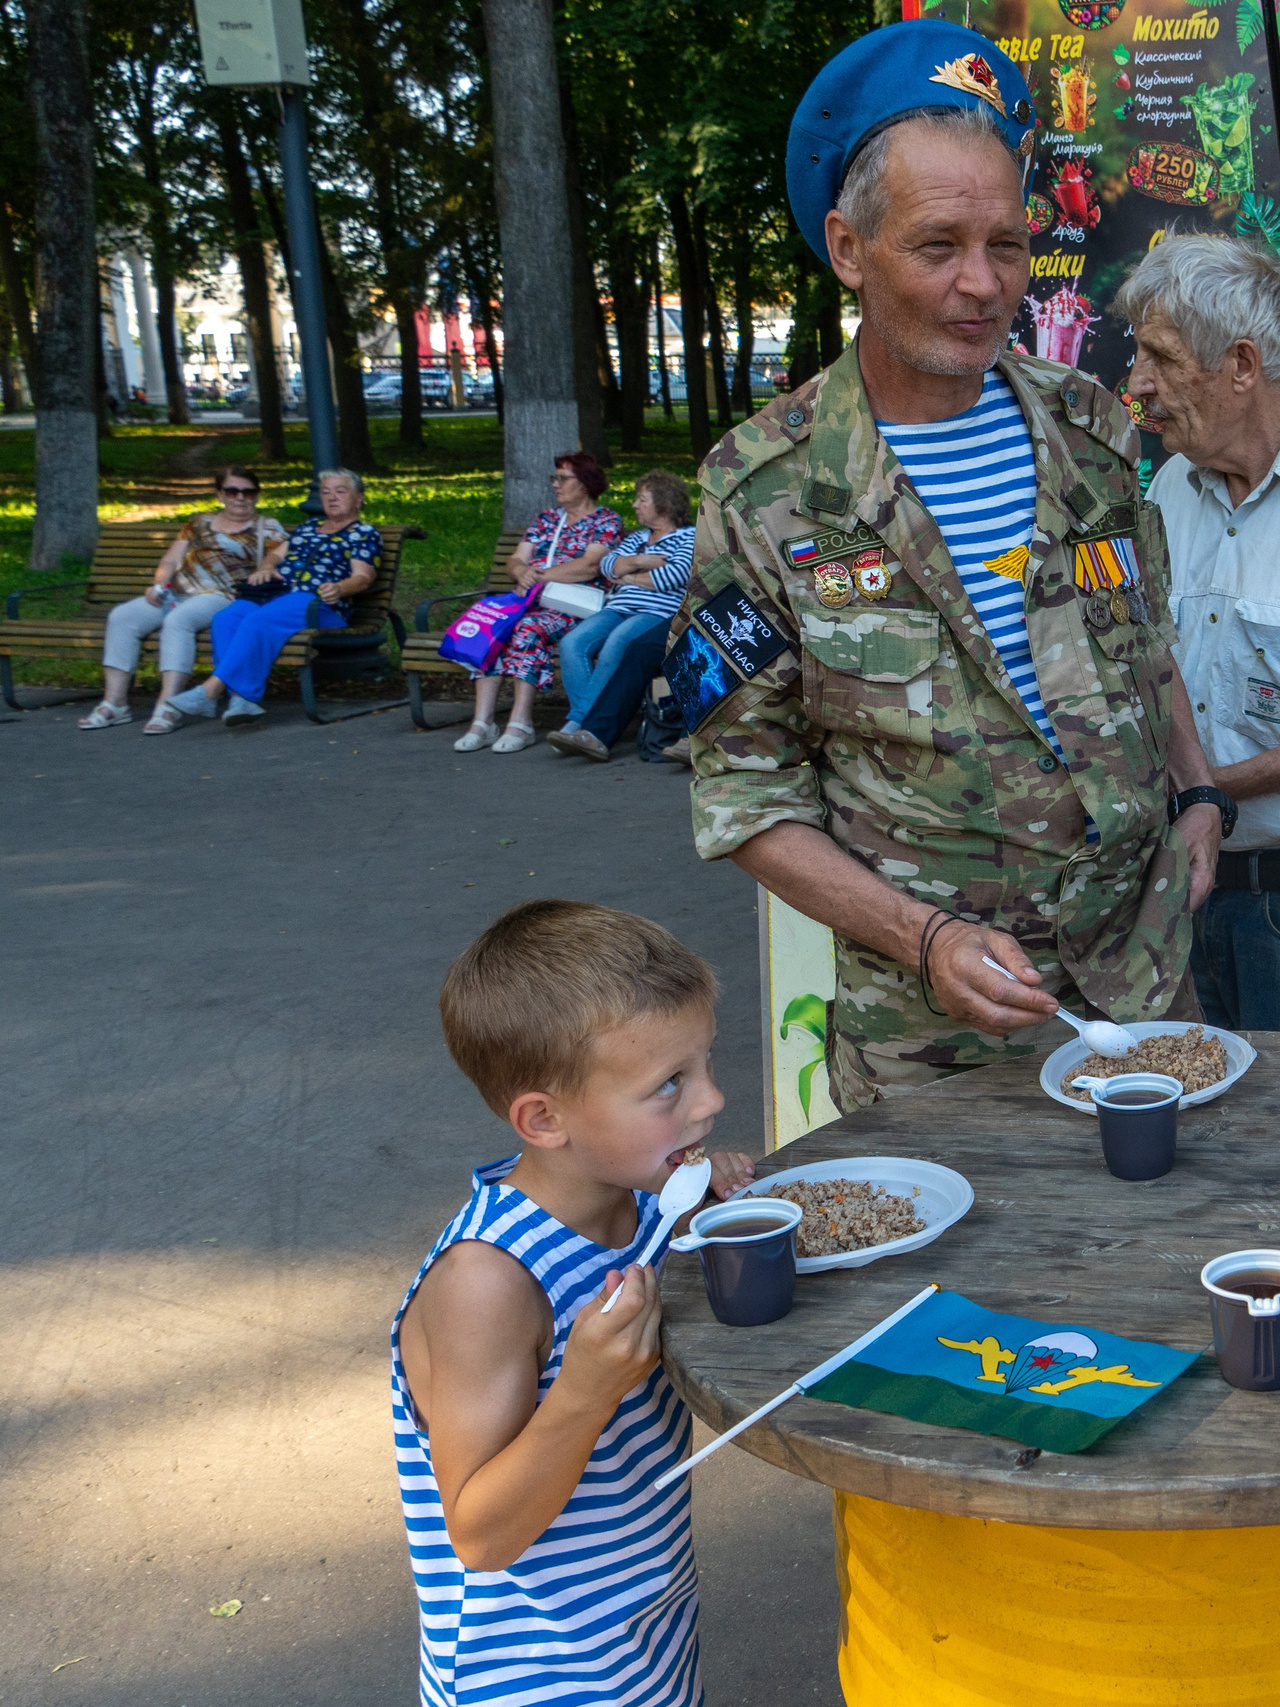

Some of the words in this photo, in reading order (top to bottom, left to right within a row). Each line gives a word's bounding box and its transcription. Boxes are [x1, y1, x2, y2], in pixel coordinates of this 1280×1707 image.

[1132, 9, 1220, 42] Мохито
[1134, 49, 1203, 66] Классический
[1135, 70, 1194, 91] Клубничный
[1135, 93, 1173, 111] Черная
[1137, 110, 1192, 128] смородина
[1041, 131, 1074, 145] Манго
[1053, 143, 1103, 159] Маракуйя
[1155, 153, 1195, 178] 250
[1156, 174, 1190, 189] РУБЛЕЙ
[1051, 222, 1085, 243] Арбуз
[1030, 248, 1086, 278] ейки
[737, 599, 772, 638] НИКТО
[699, 609, 734, 650] КРОМЕ
[731, 647, 755, 672] НАС
